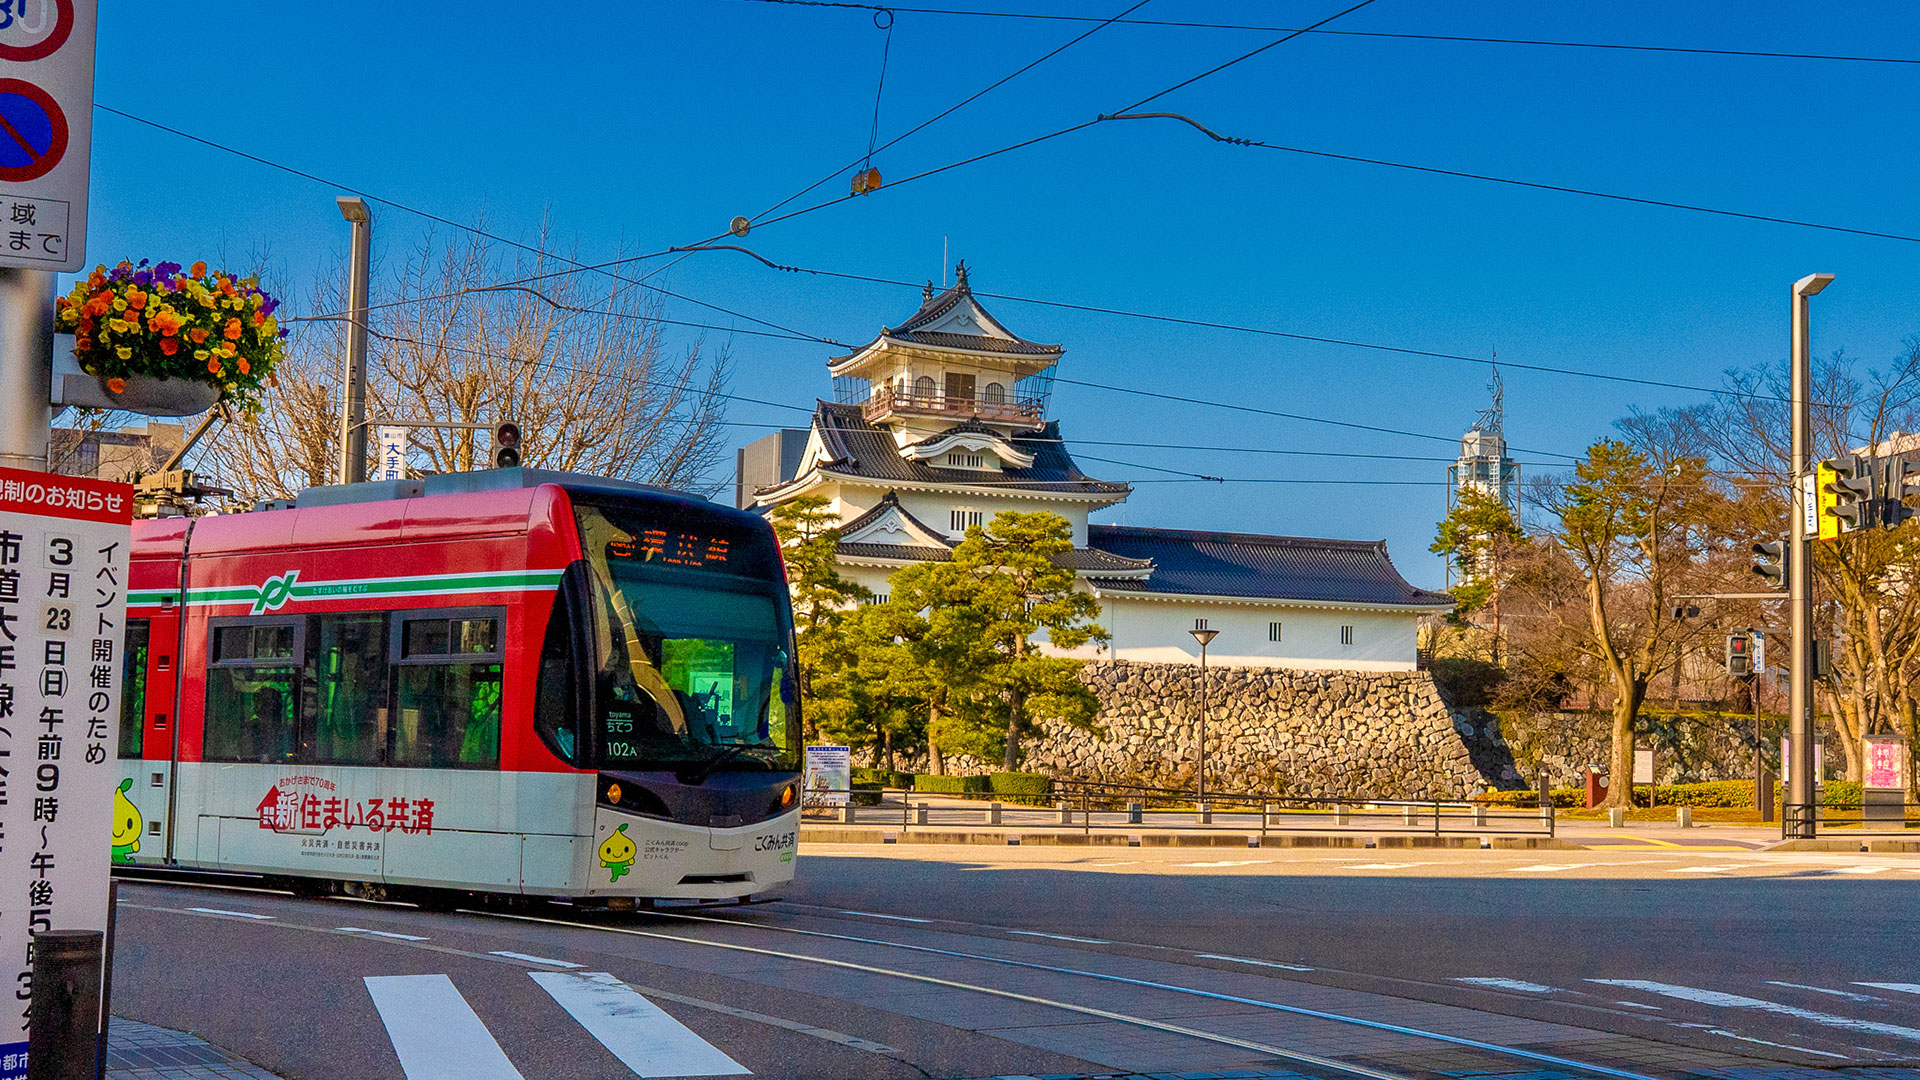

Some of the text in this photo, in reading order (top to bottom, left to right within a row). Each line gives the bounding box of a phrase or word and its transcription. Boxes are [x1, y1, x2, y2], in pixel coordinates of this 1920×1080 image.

[0, 230, 61, 254] まで
[386, 442, 400, 480] 大手町
[0, 479, 123, 513] 制のお知らせ
[85, 541, 120, 765] イベント開催のため
[609, 711, 632, 719] toyama
[607, 722, 633, 733] ちてつ
[607, 742, 638, 757] 102A
[278, 775, 337, 792] おかげさまで70周年
[275, 791, 435, 836] 新住まいる共済
[754, 832, 795, 852] こくみん共済
[0, 1052, 29, 1071] 都市
